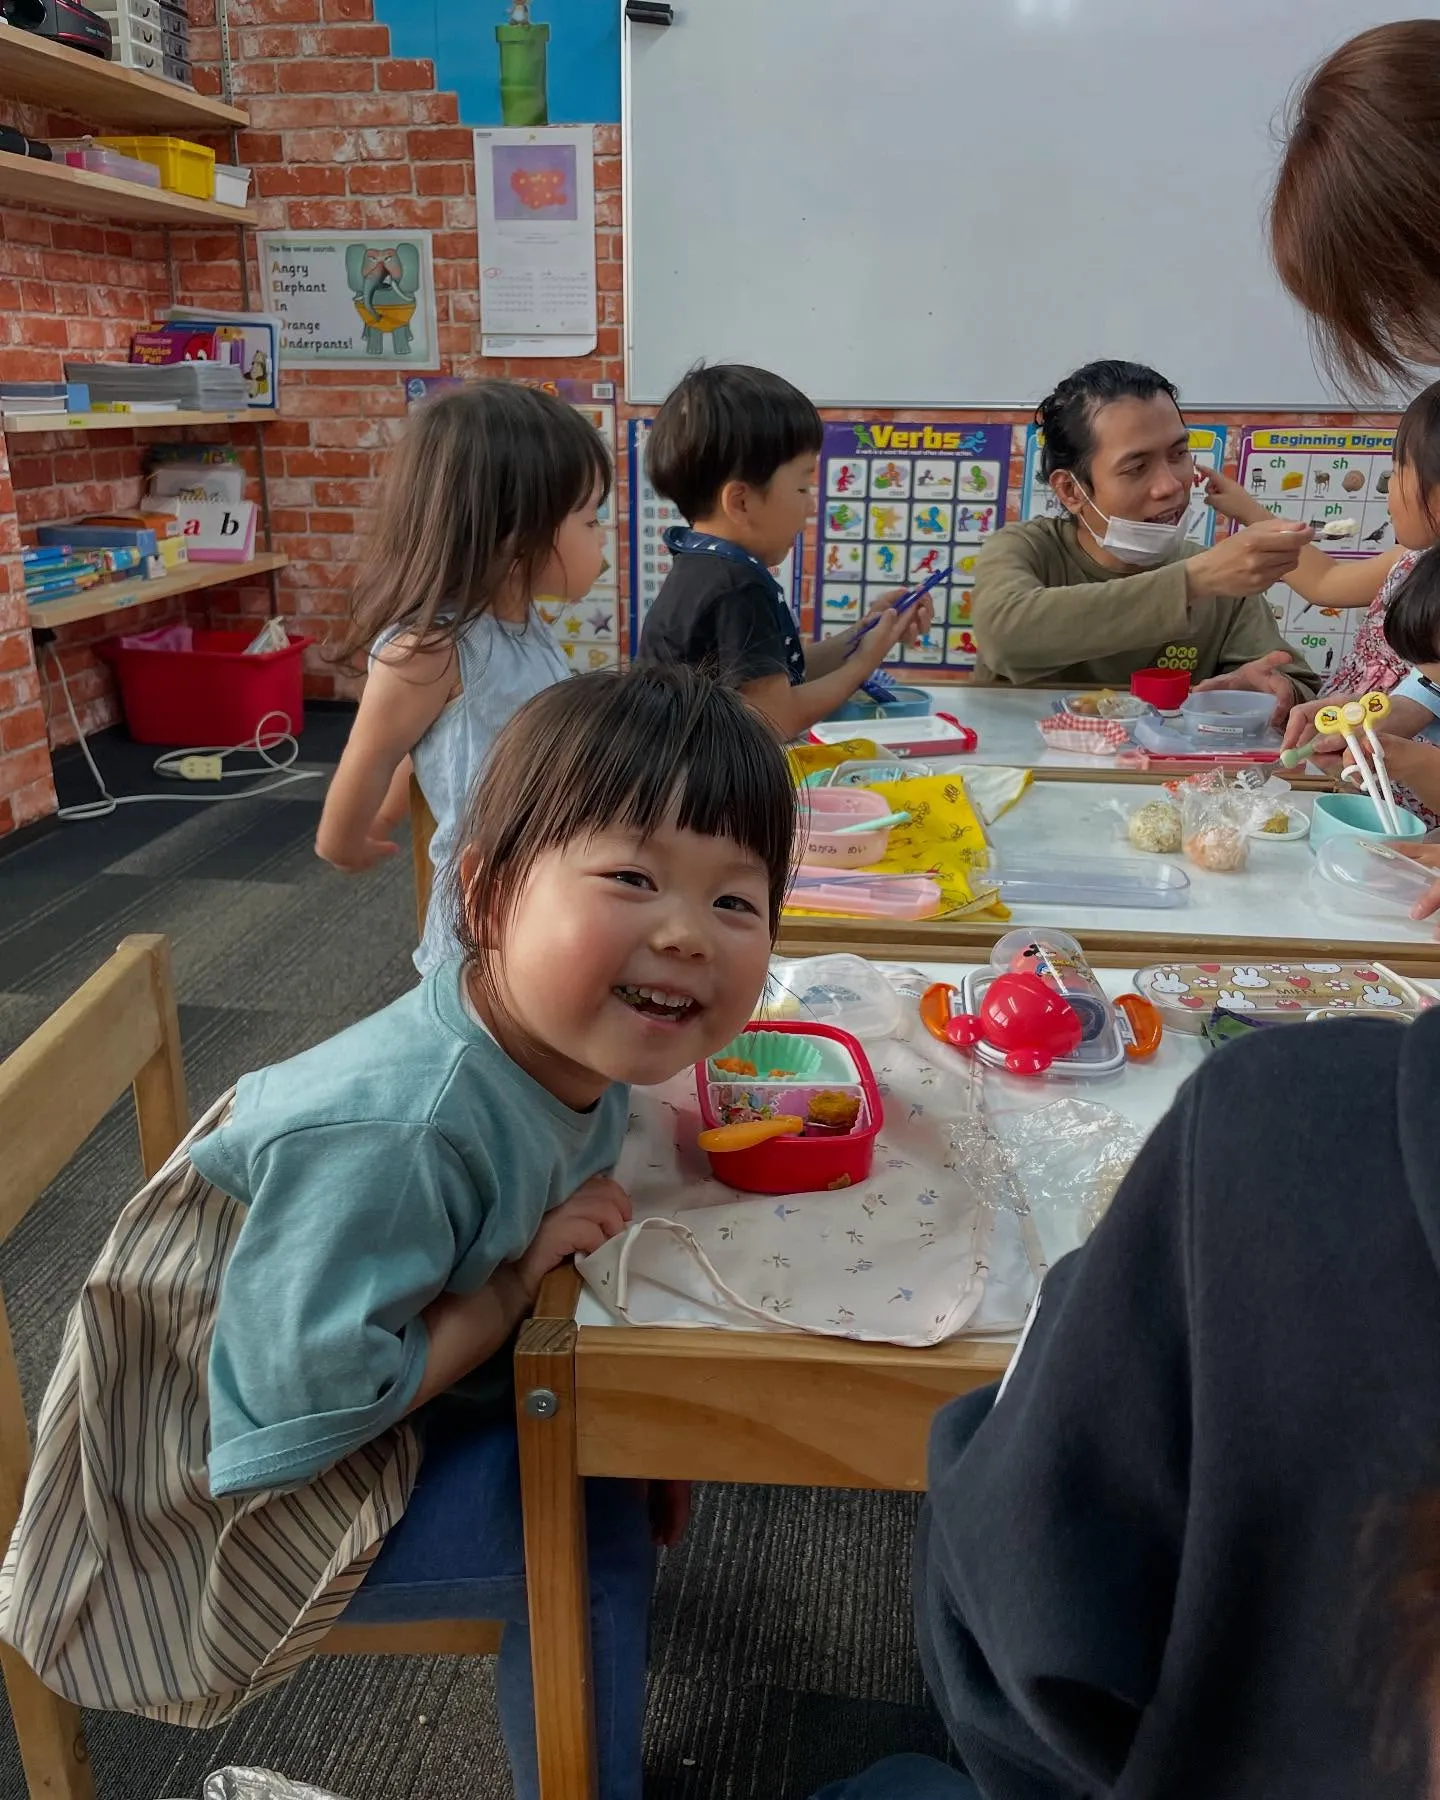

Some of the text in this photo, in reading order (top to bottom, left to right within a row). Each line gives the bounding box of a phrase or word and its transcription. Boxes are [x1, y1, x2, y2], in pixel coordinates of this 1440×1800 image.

[272, 261, 309, 277] Angry
[272, 280, 327, 297] Elephant
[274, 299, 288, 311] In
[280, 336, 353, 351] Underpants!
[870, 425, 961, 449] Verbs
[1269, 434, 1346, 447] Beginning
[1269, 456, 1286, 468] ch
[1332, 457, 1349, 470] sh
[1324, 503, 1342, 517] ph
[183, 511, 240, 536] a b
[1301, 634, 1327, 648] dge
